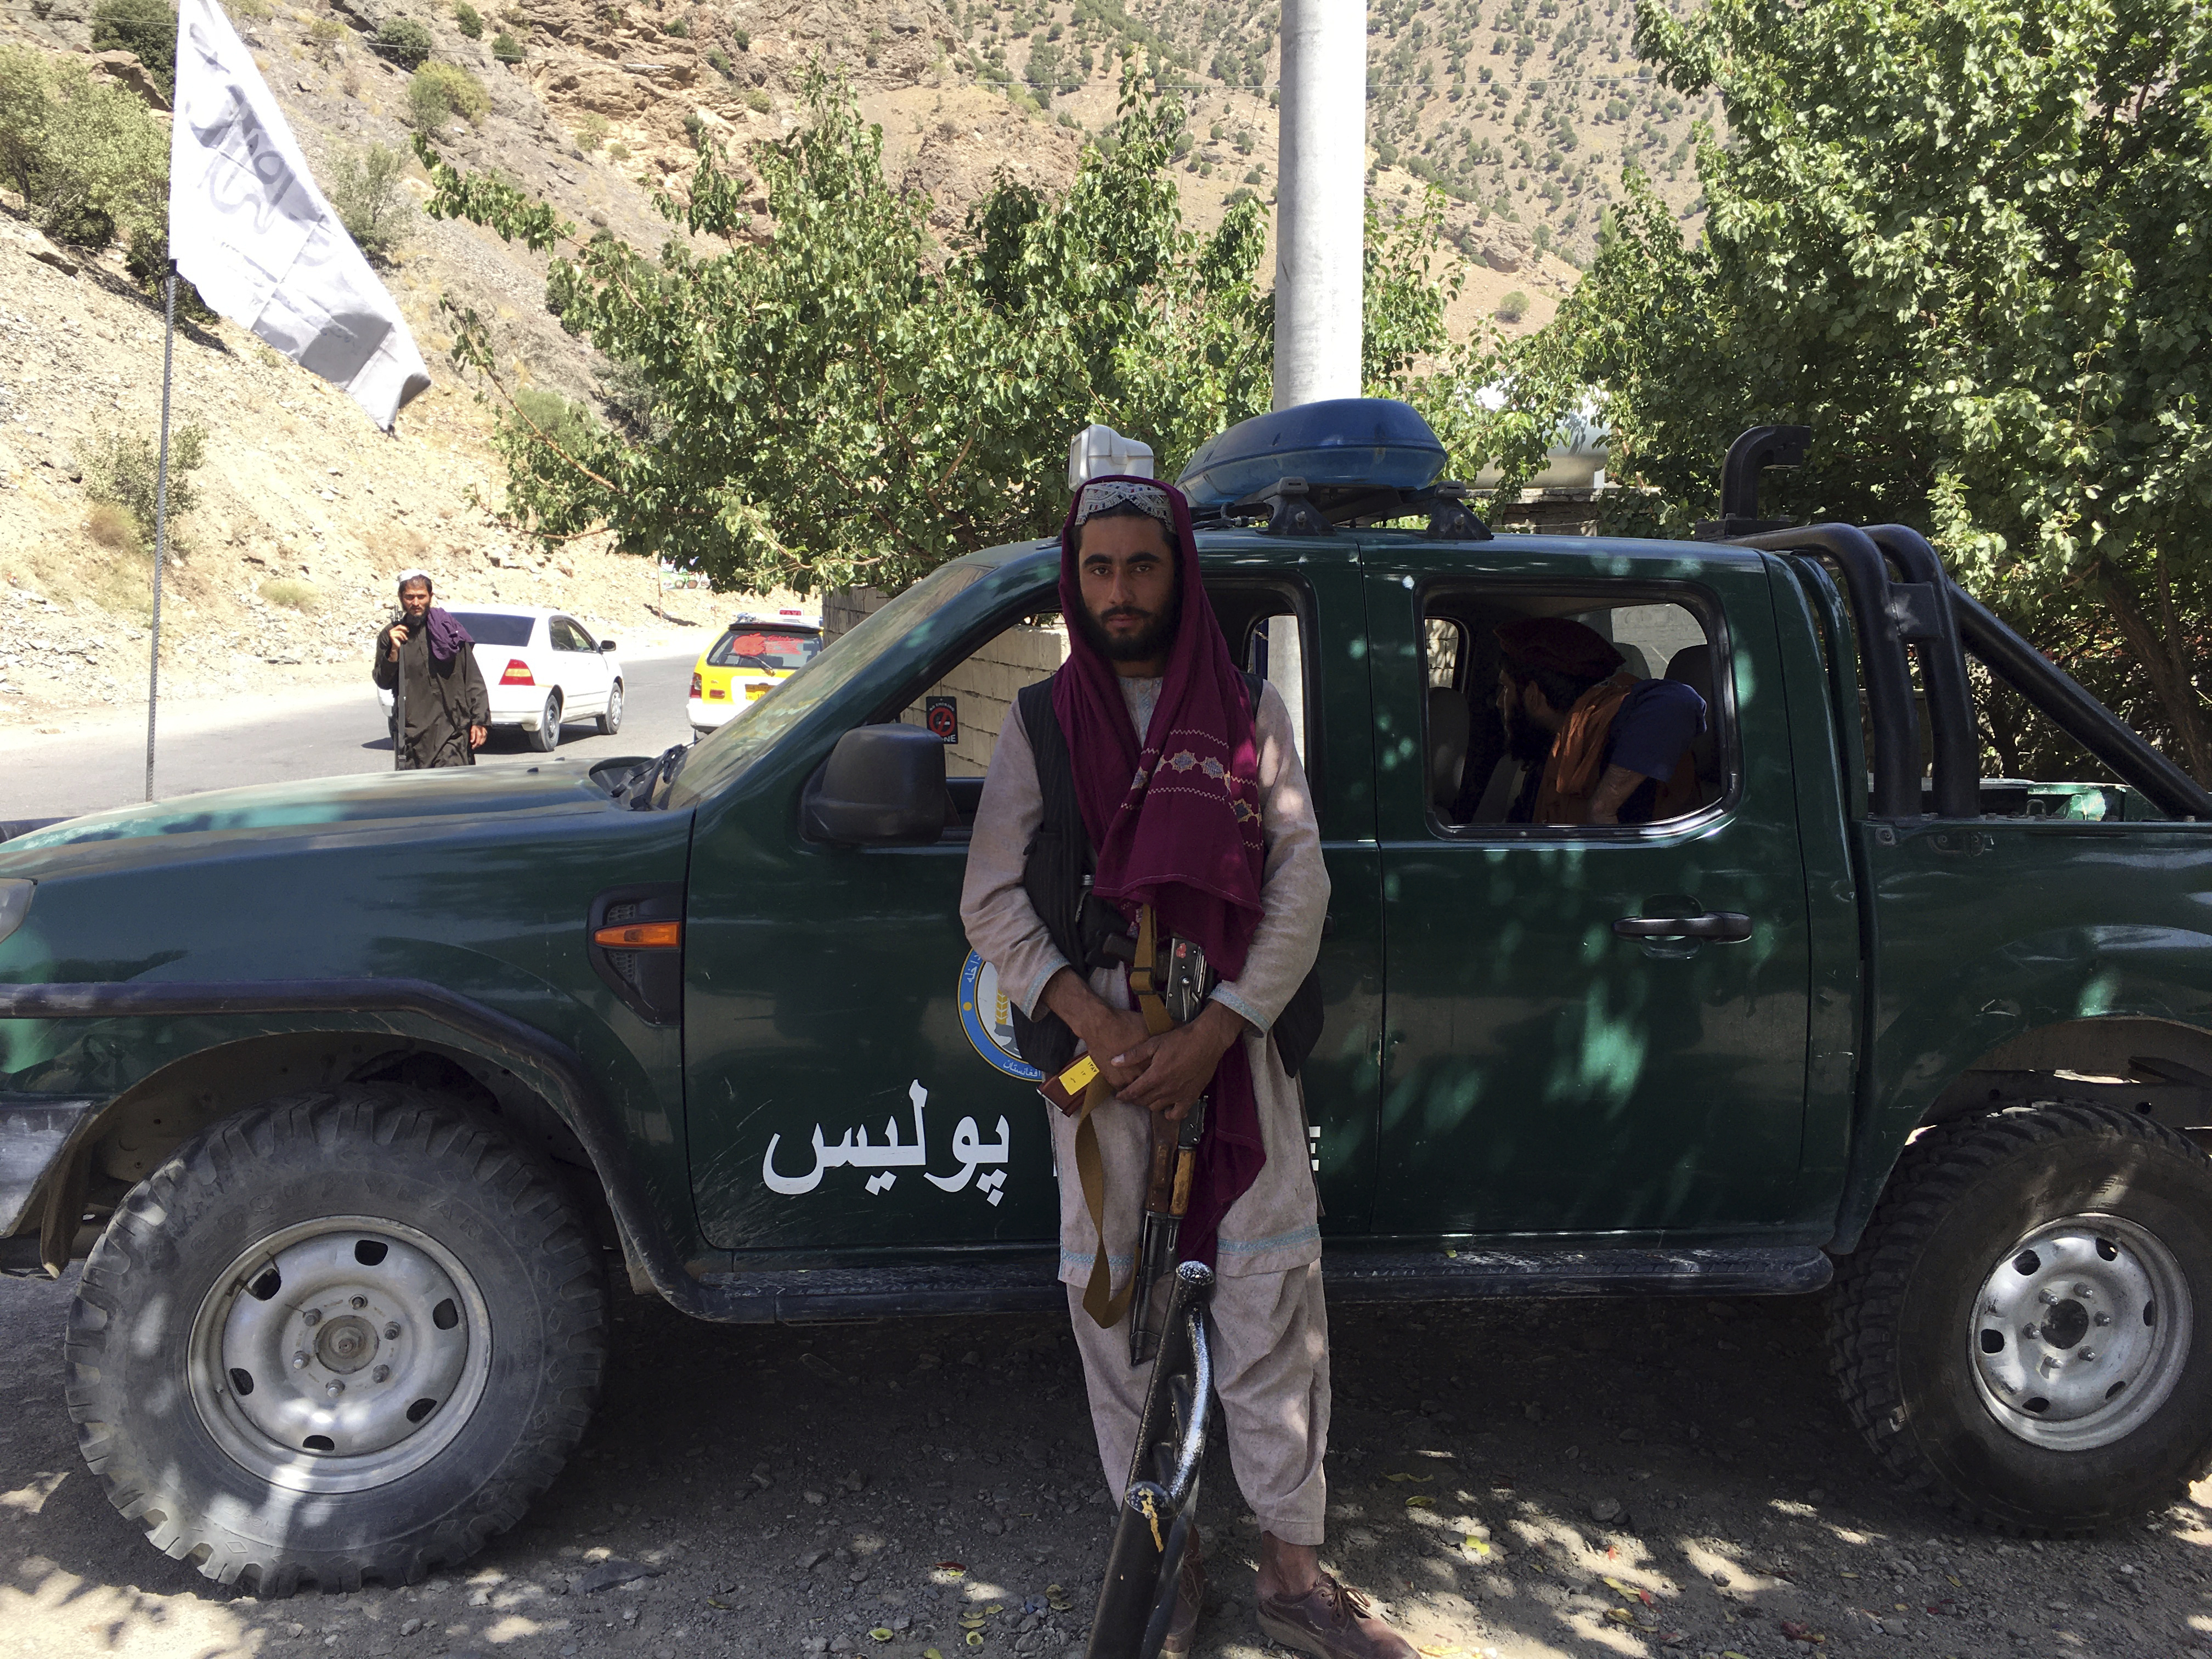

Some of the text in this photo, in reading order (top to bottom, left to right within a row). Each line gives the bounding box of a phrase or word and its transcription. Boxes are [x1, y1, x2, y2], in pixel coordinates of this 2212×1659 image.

[941, 734, 956, 742] NE
[1003, 1059, 1041, 1077] افغانستان
[762, 1079, 1010, 1207] پولیس
